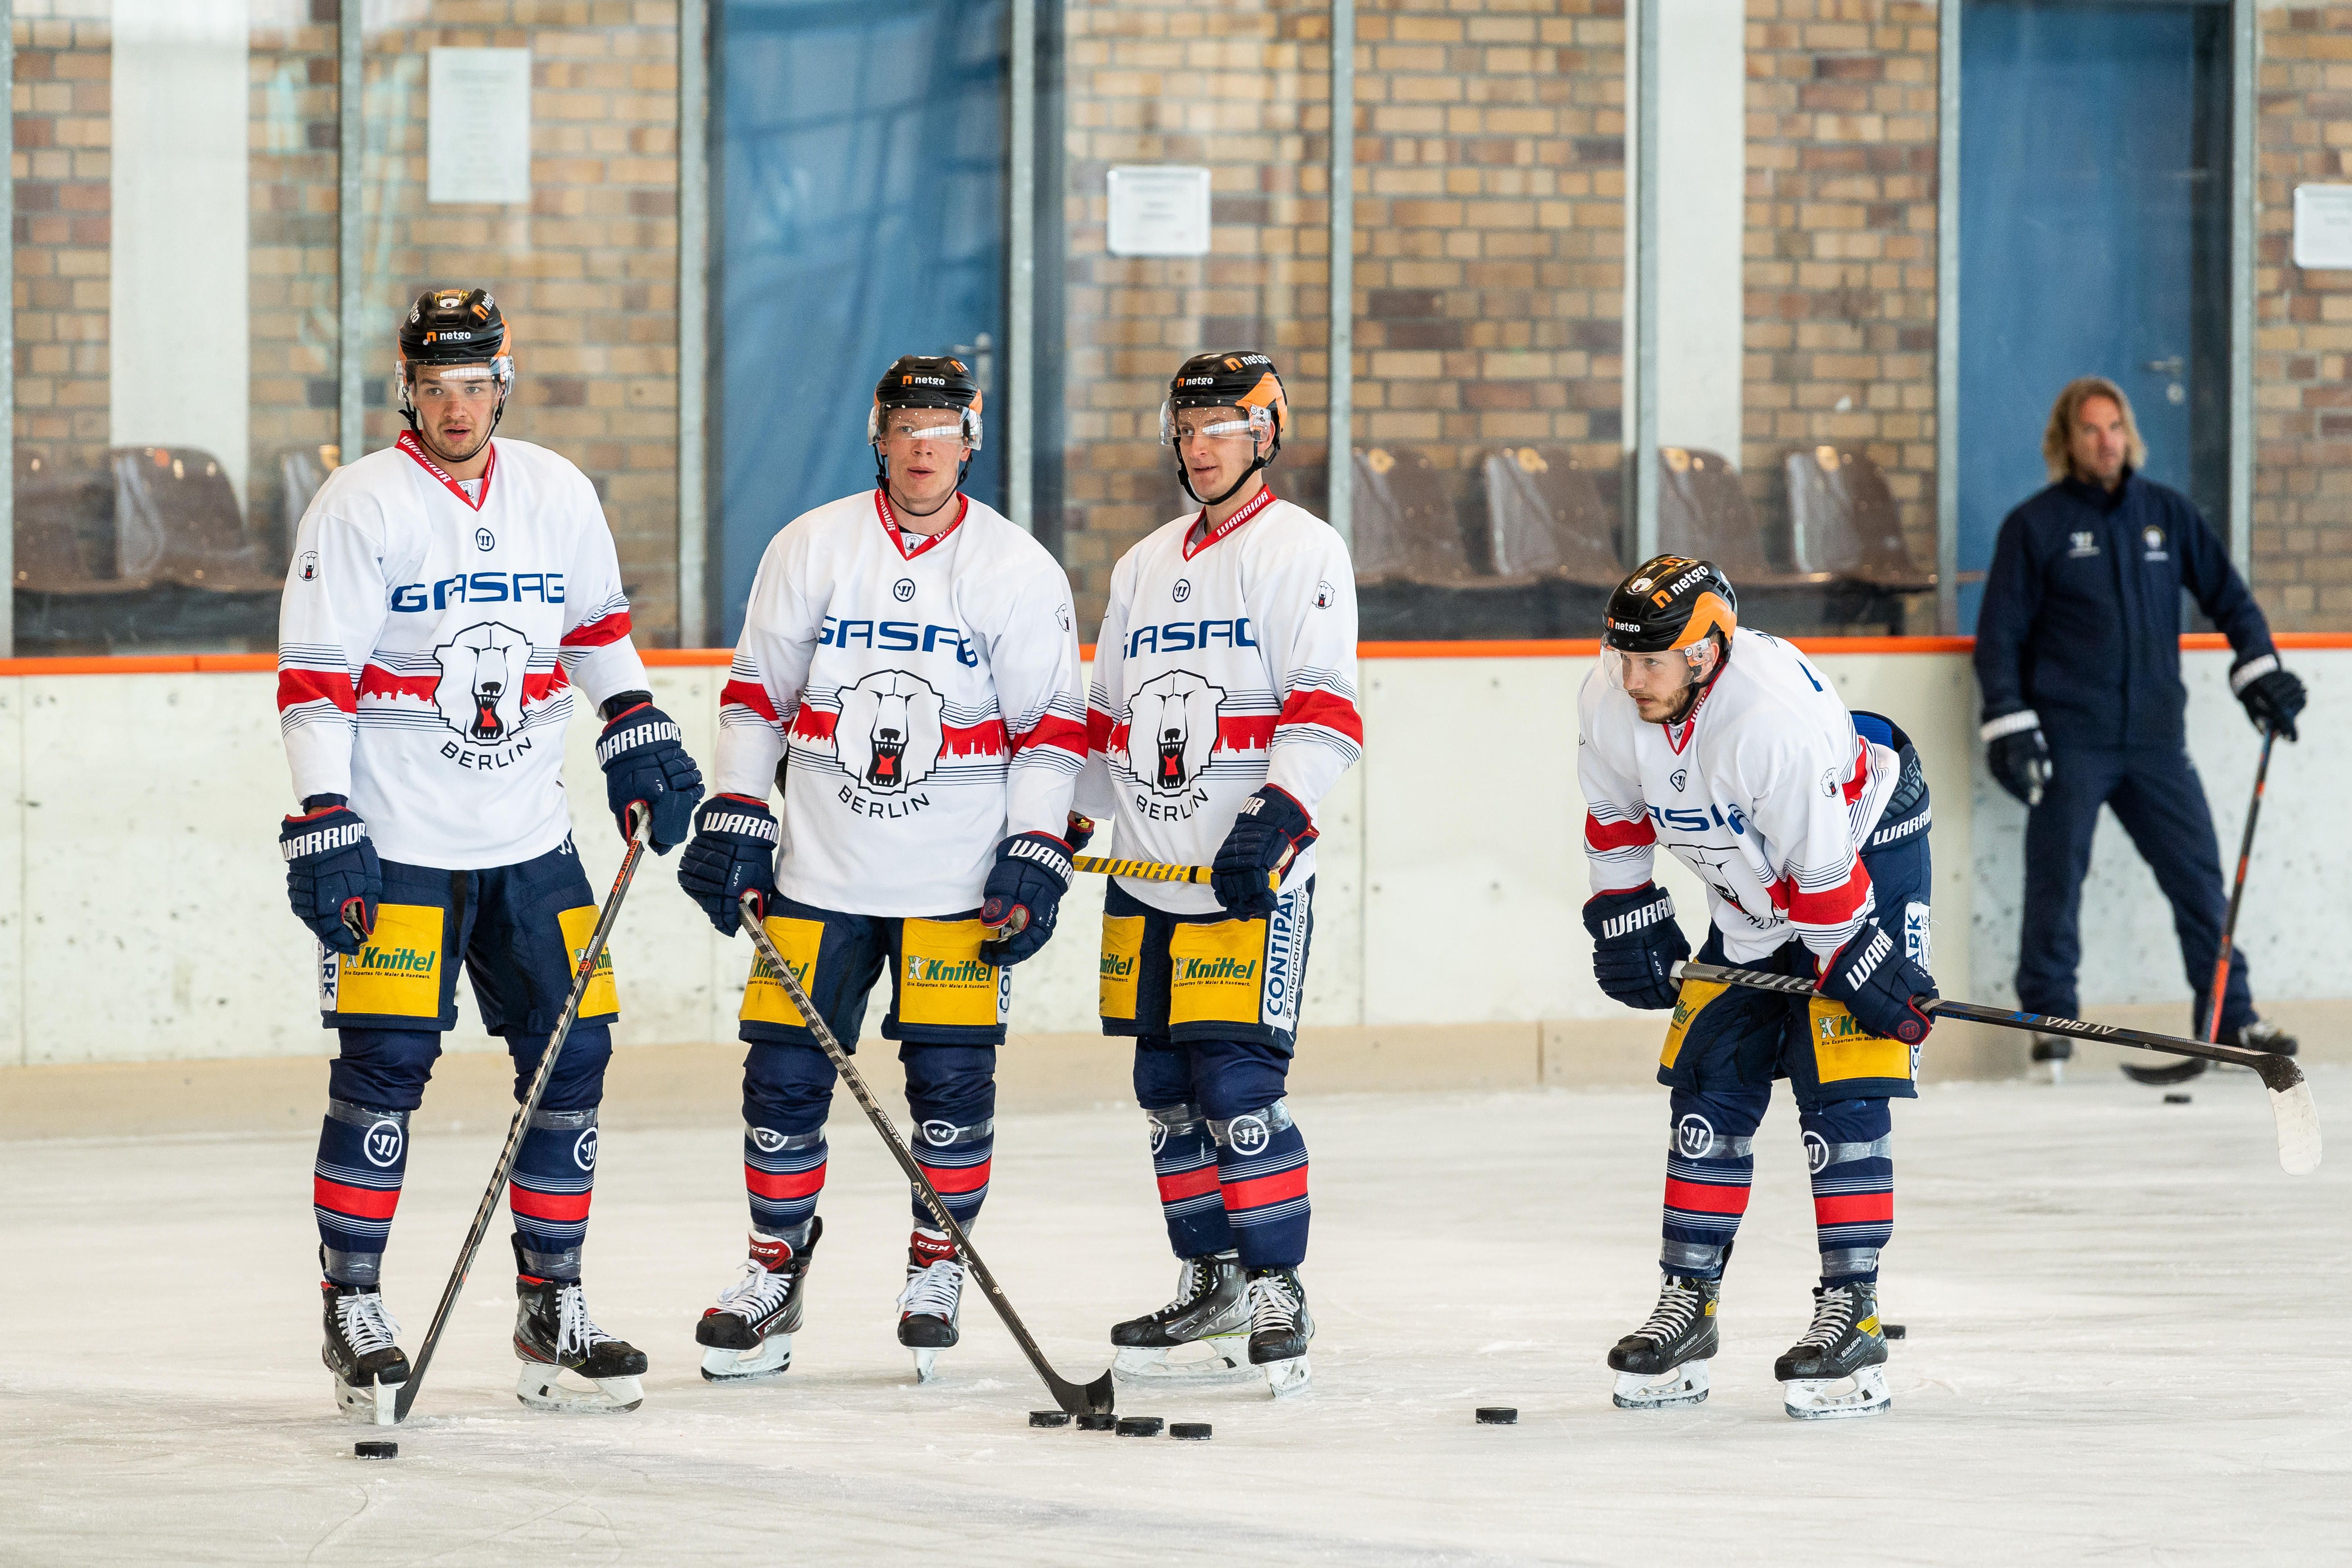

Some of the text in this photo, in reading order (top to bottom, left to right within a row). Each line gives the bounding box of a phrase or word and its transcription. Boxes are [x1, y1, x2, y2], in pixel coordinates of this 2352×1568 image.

[440, 331, 471, 340] netgo
[1241, 354, 1272, 365] netgo
[915, 376, 945, 385] netgo
[1186, 377, 1213, 385] netgo
[400, 436, 451, 483] WARRIOR
[1216, 491, 1269, 537] WARRIOR
[1670, 565, 1709, 595] netgo
[391, 572, 564, 612] GASAG
[1615, 622, 1640, 632] netgo
[440, 737, 533, 771] BERLIN
[838, 784, 930, 819] BERLIN
[1136, 787, 1209, 822] BERLIN
[361, 946, 436, 972] Knittel
[925, 959, 993, 981] Knittel
[1185, 958, 1256, 979] Knittel
[2045, 1016, 2118, 1035] ALPHA
[912, 1182, 951, 1240] ALPHA
[750, 1244, 779, 1254] CCM
[917, 1240, 950, 1251] CCM
[764, 1310, 787, 1334] CCM
[1675, 1333, 1698, 1357] BAUER
[1841, 1336, 1862, 1358] BAUER
